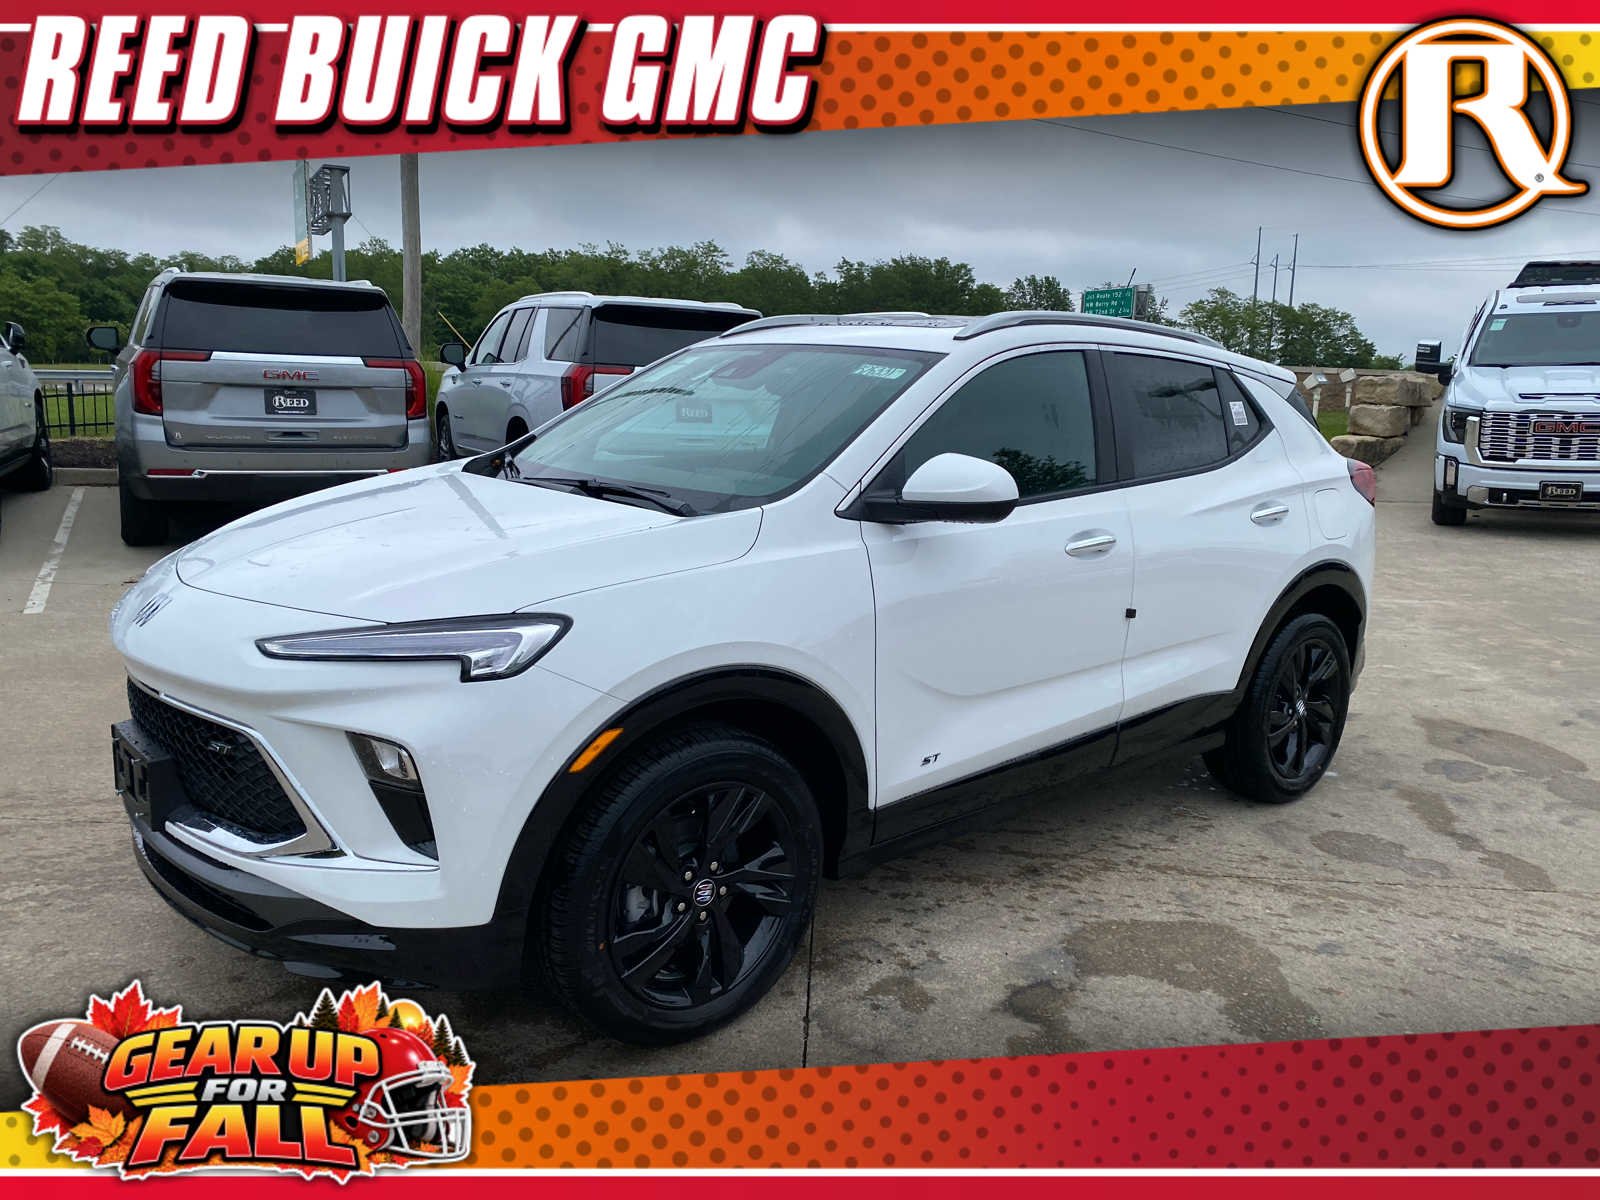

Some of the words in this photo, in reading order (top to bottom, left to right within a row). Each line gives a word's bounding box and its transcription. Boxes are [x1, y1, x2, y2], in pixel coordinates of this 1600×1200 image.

[263, 369, 320, 381] GMC
[273, 395, 309, 409] REED
[1535, 422, 1600, 433] GMC
[919, 752, 942, 767] ST
